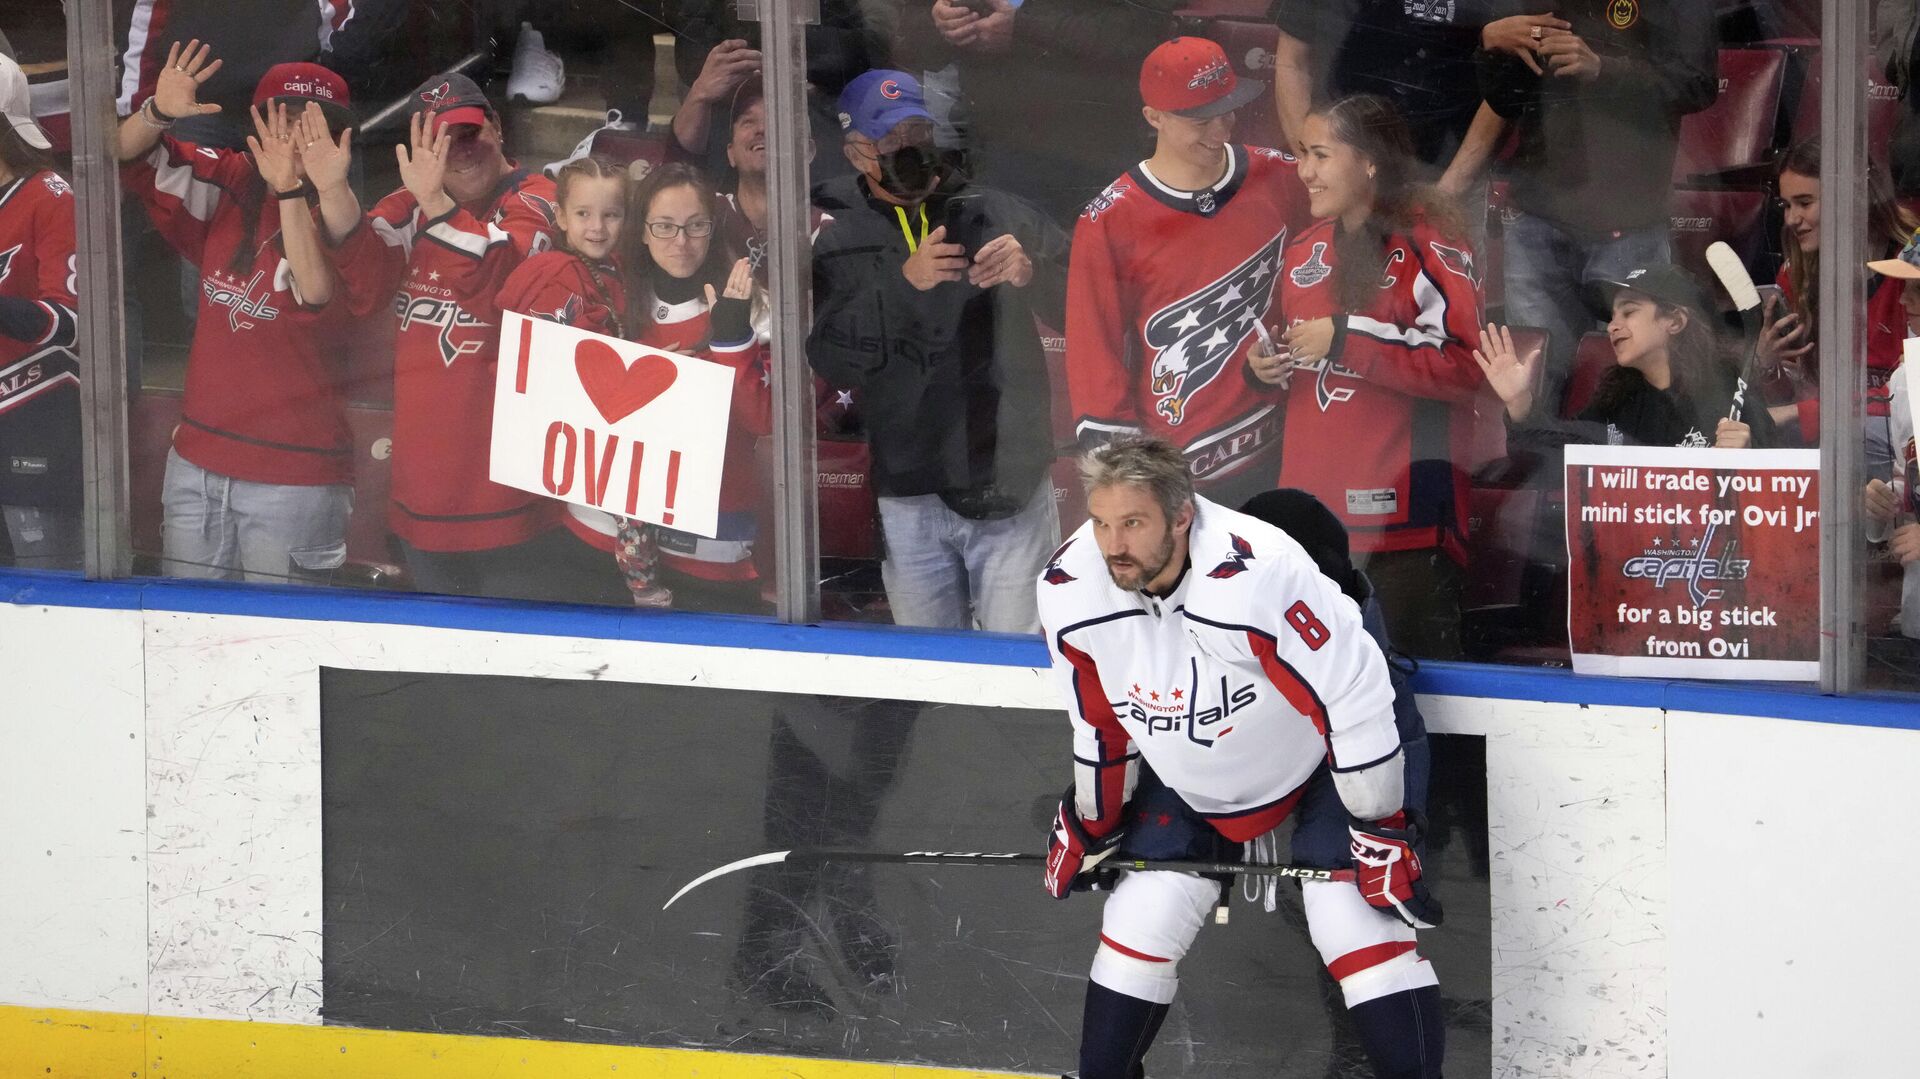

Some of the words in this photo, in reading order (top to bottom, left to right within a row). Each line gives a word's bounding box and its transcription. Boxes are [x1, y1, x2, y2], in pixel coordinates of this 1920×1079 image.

[881, 80, 902, 100] C
[515, 317, 533, 395] I
[1588, 467, 1594, 488] I
[1601, 468, 1638, 489] will
[1645, 470, 1709, 491] trade
[1716, 475, 1762, 497] you
[1771, 475, 1811, 499] my
[1581, 501, 1628, 523] mini
[1634, 503, 1693, 525] stick
[1699, 504, 1736, 526] for
[1743, 505, 1787, 527] Ovi
[1793, 505, 1820, 533] Jr
[1623, 524, 1750, 605] capitals
[1644, 549, 1698, 557] WASHINGTON
[1284, 600, 1331, 651] 8
[1617, 603, 1652, 623] for
[1659, 608, 1671, 624] a
[1677, 605, 1713, 630] big
[1720, 606, 1777, 626] stick
[1646, 636, 1700, 657] from
[1708, 638, 1749, 657] Ovi
[1128, 690, 1184, 712] WASHINGTON
